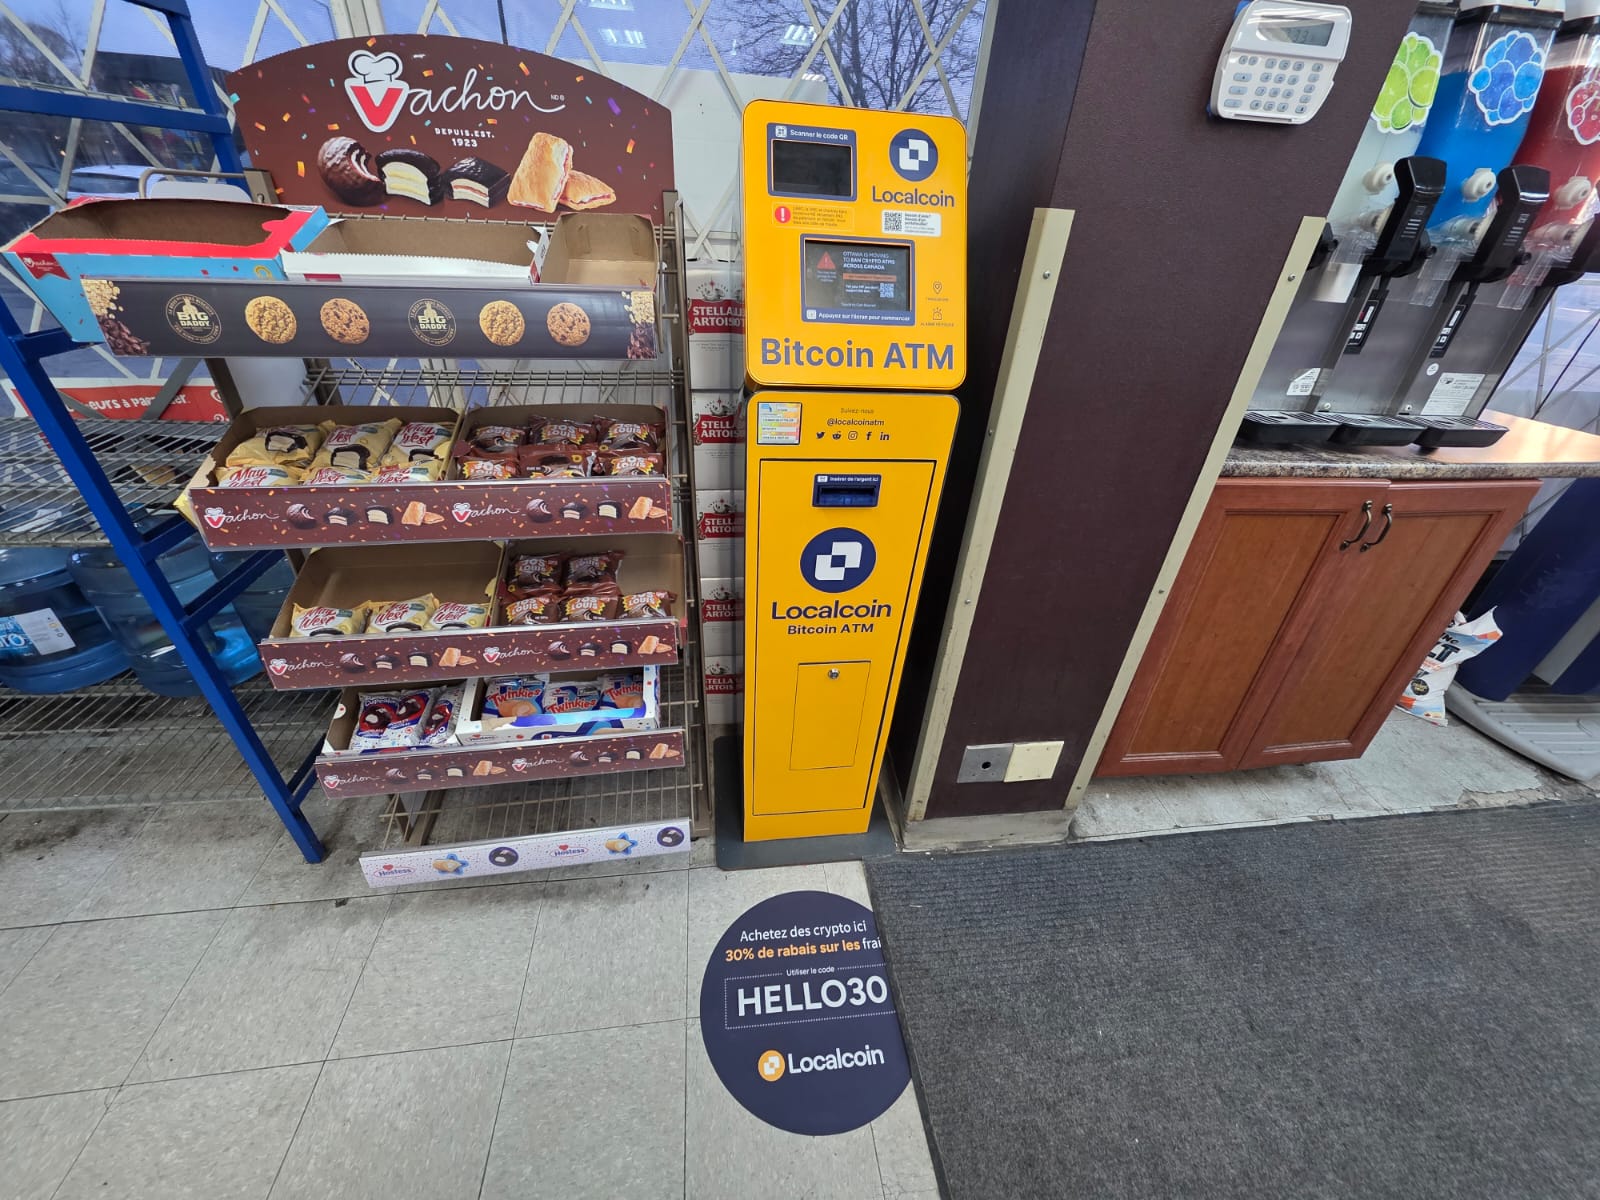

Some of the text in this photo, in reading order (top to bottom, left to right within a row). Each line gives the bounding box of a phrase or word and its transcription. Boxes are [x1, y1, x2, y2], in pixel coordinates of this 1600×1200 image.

[344, 69, 565, 132] Vachon
[790, 129, 815, 137] Scanner
[452, 138, 478, 147] 1923
[872, 186, 955, 208] Localcoin
[176, 311, 209, 321] BIG
[692, 306, 732, 316] STELLA
[818, 312, 841, 320] Appuyez
[417, 315, 446, 324] BIG
[692, 317, 733, 327] ARTOIS
[761, 337, 953, 370] Bitcoin ATM
[827, 418, 885, 426] @localcoinatm
[204, 507, 280, 528] Vachon
[452, 504, 519, 523] Vachon
[571, 602, 598, 610] LOUIS
[629, 597, 655, 606] LOUIS
[771, 599, 892, 619] Localcoin
[300, 615, 335, 628] West
[787, 623, 874, 634] Bitcoin ATM
[483, 646, 542, 664] Vachon
[269, 658, 334, 676] Vachon
[488, 688, 542, 707] Twinkies
[547, 699, 597, 714] Twinkies
[554, 848, 585, 856] Hostess
[740, 920, 867, 942] Achetez des crypto ici
[725, 936, 882, 962] 30% de rabais sur les frai
[786, 966, 835, 977] Utiliser le code
[737, 975, 888, 1017] HELLO30
[788, 1045, 885, 1074] Localcoin
